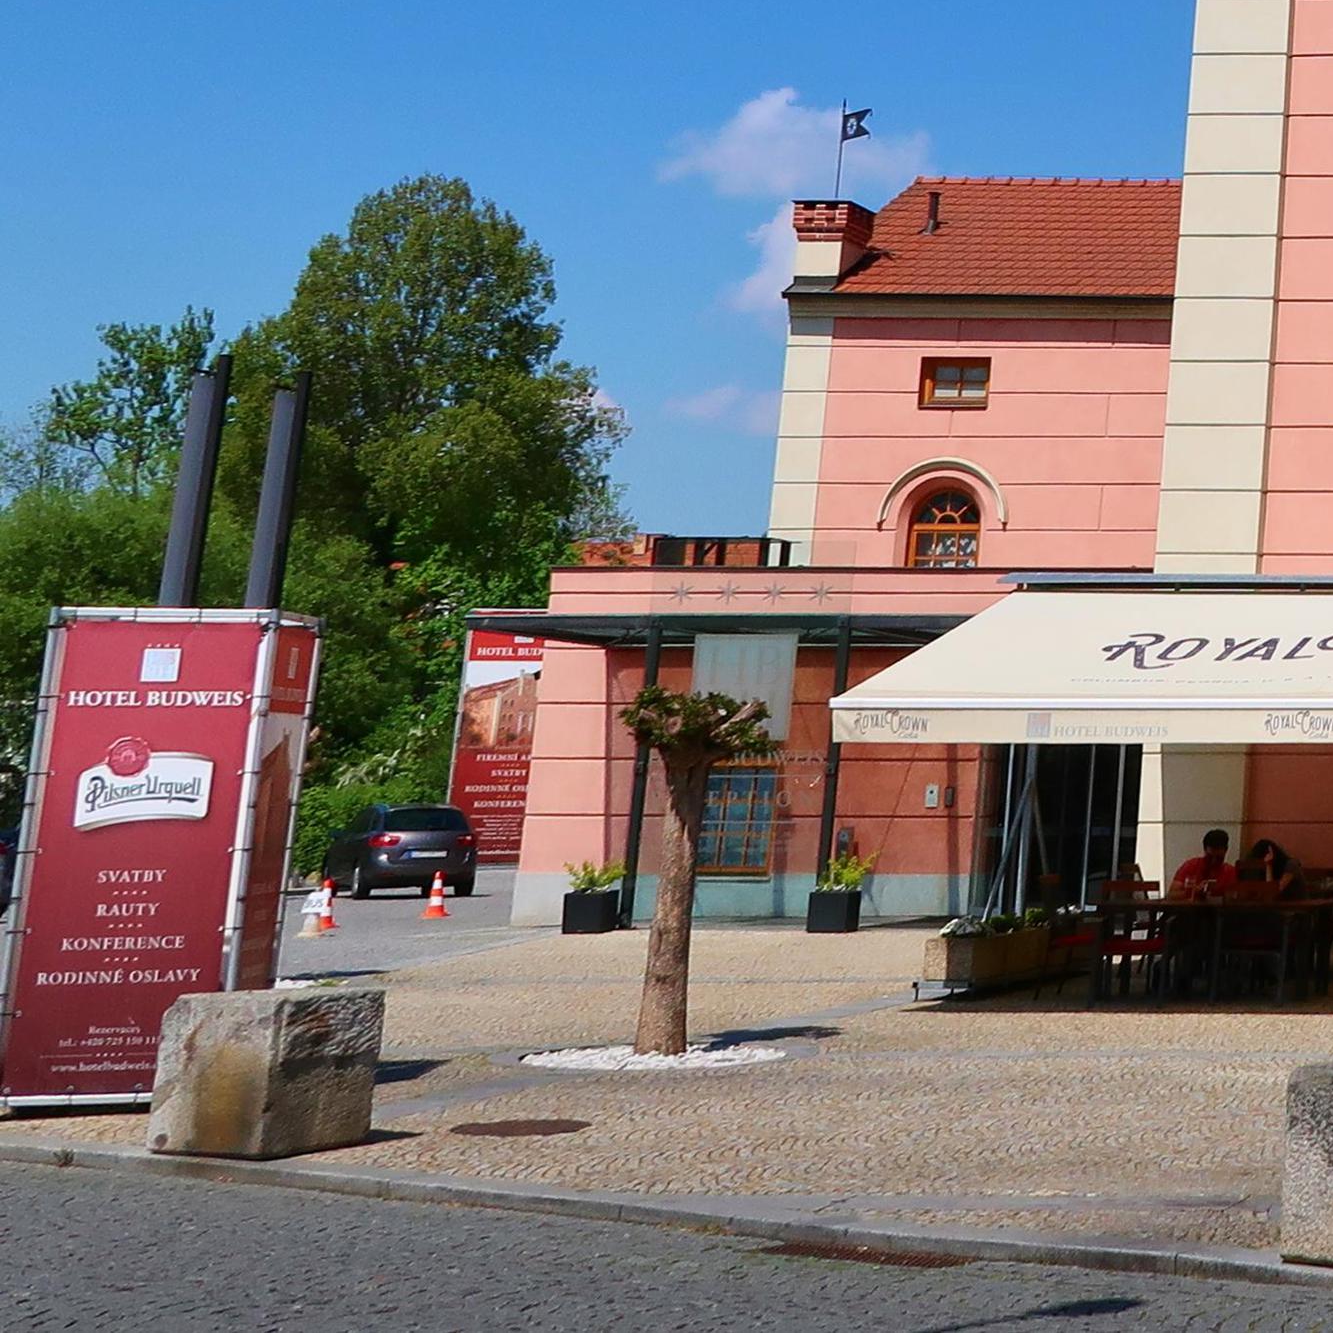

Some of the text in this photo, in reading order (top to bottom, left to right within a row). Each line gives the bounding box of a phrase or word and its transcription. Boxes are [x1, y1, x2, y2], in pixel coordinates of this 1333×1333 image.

[477, 647, 515, 656] HOTEL
[1101, 633, 1318, 670] ROYAL
[67, 691, 244, 707] HOTEL BUDWEIS
[853, 709, 928, 736] ROYAL CROWN
[1264, 713, 1296, 736] ROYAL
[1054, 725, 1168, 738] HOTEL BUDWEIS
[84, 773, 202, 813] Pilsner Urquell
[97, 869, 167, 884] SVATBY
[96, 903, 160, 917] RAUTY
[60, 935, 186, 952] KONFERENCE
[35, 968, 202, 986] RODINNÉ OSLAVY
[50, 1060, 157, 1073] www.hotelbudweis.
